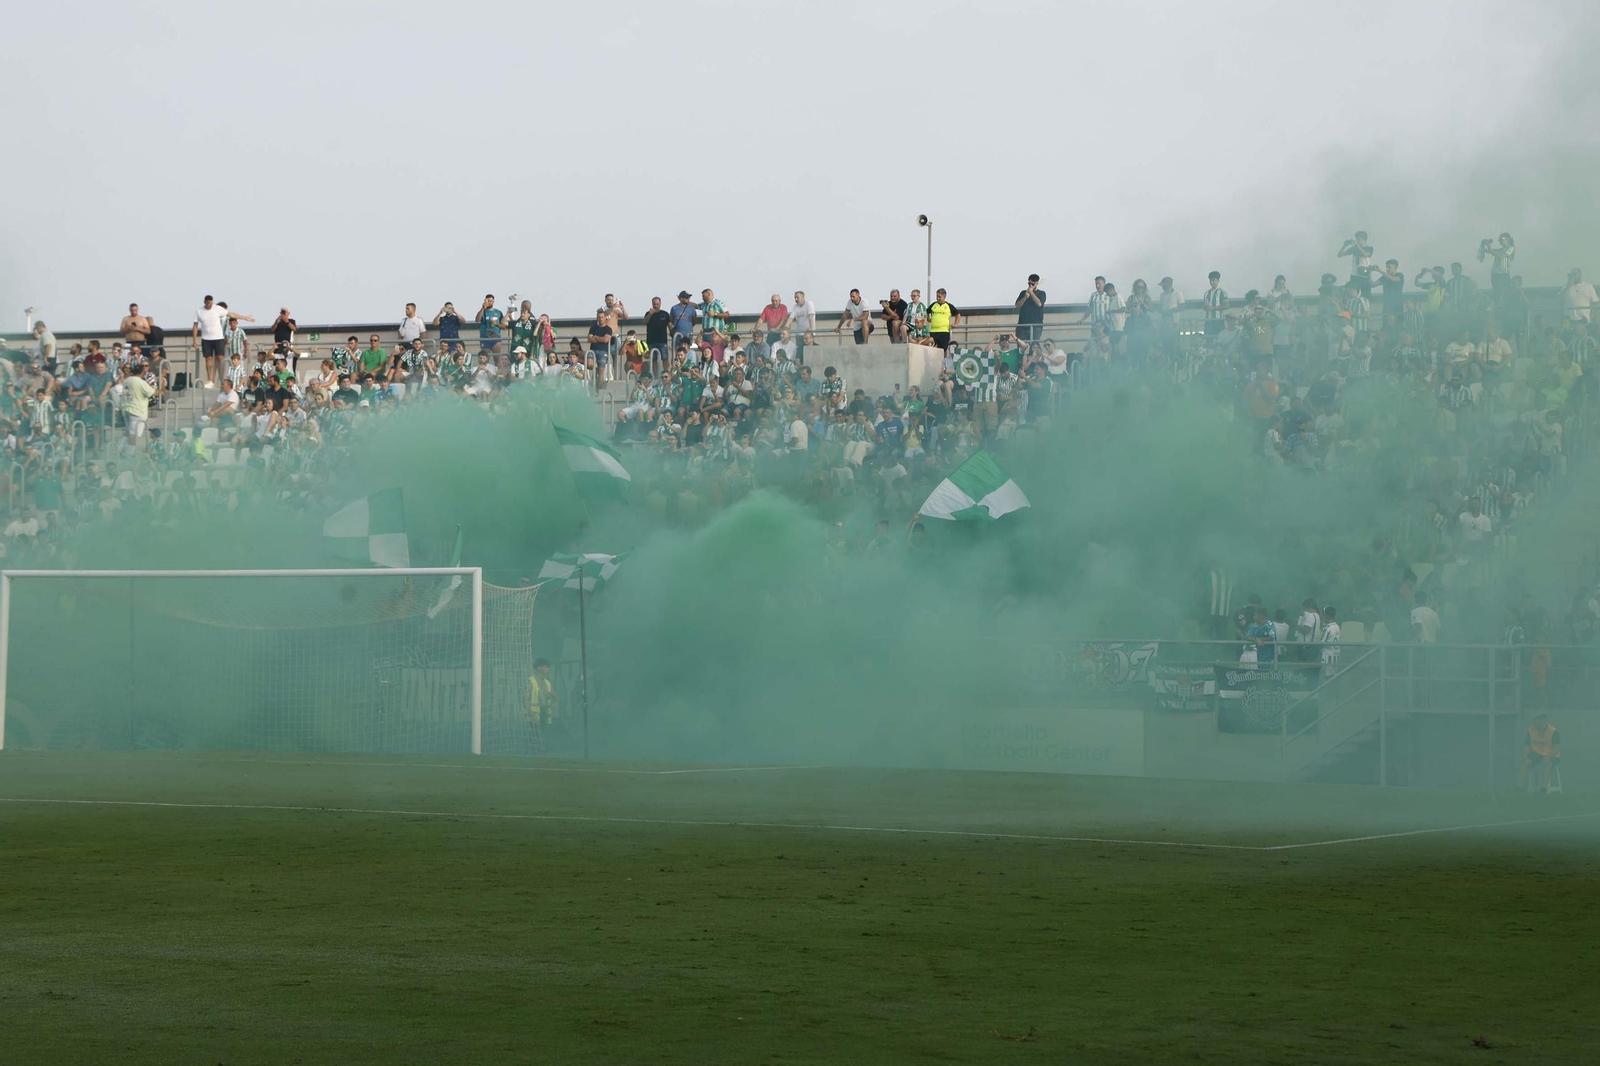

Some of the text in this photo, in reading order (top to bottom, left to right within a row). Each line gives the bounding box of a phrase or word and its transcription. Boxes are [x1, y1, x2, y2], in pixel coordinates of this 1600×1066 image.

[1166, 699, 1184, 709] THAT
[960, 722, 1047, 741] Marbella
[1044, 743, 1112, 763] Center
